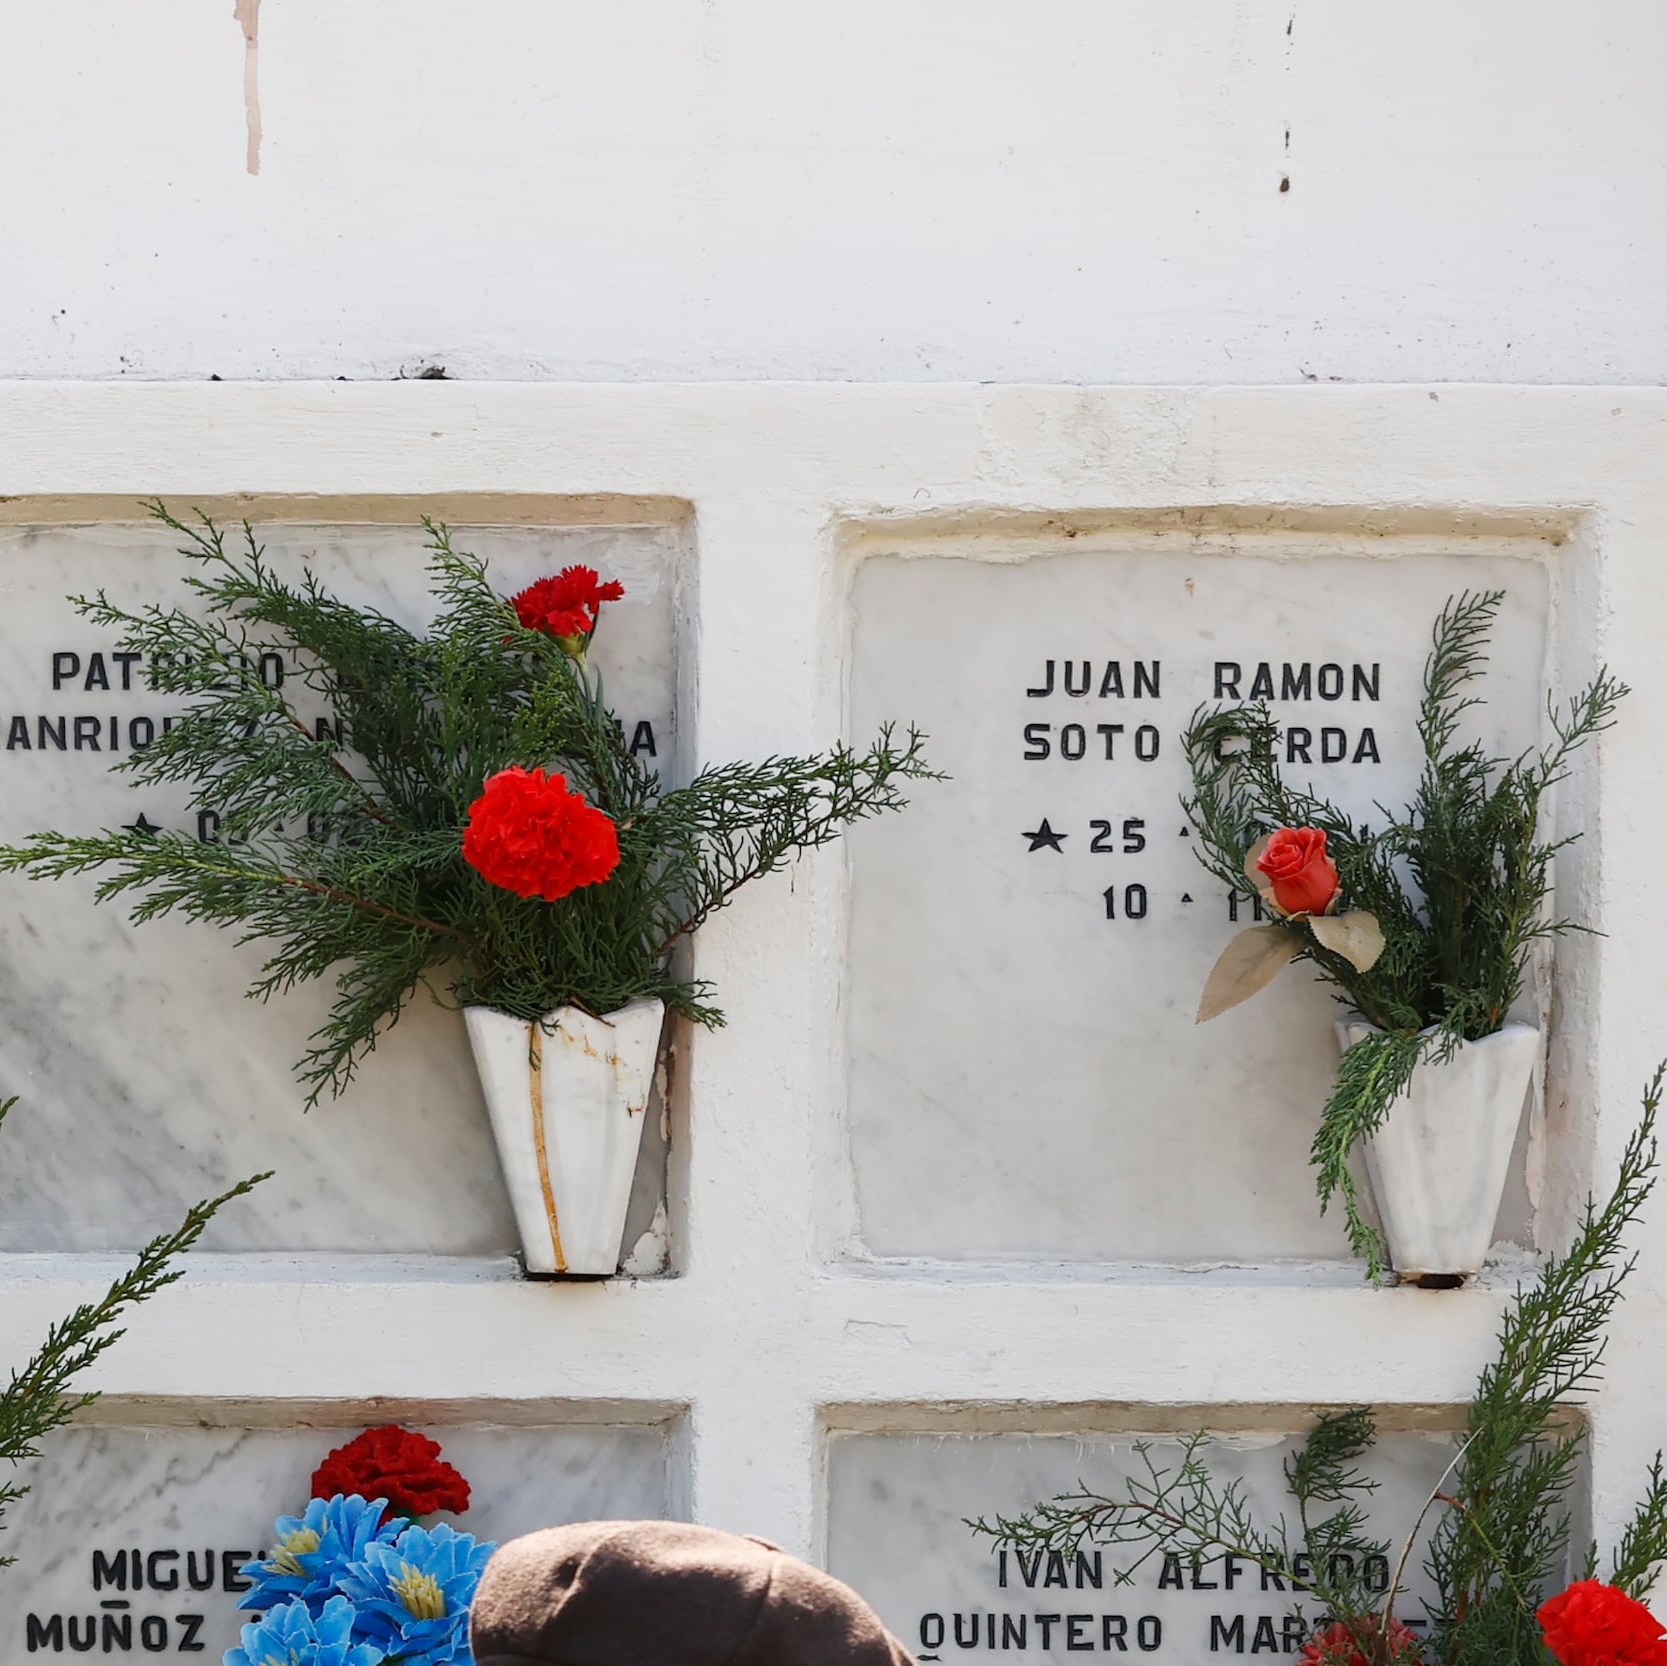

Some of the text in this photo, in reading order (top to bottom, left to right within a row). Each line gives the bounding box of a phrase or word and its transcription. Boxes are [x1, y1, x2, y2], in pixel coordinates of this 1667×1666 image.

[52, 651, 285, 691] PATIO
[1026, 659, 1380, 702] JUAN RAMON
[1023, 723, 1160, 762] SOTO
[1089, 819, 1145, 854] 25
[1104, 883, 1147, 921] 10
[92, 1548, 268, 1593] MIGUE
[997, 1549, 1391, 1593] IVAN ALFREDO
[26, 1600, 205, 1653] MUÑOZ
[918, 1611, 1163, 1660] QUINTERO
